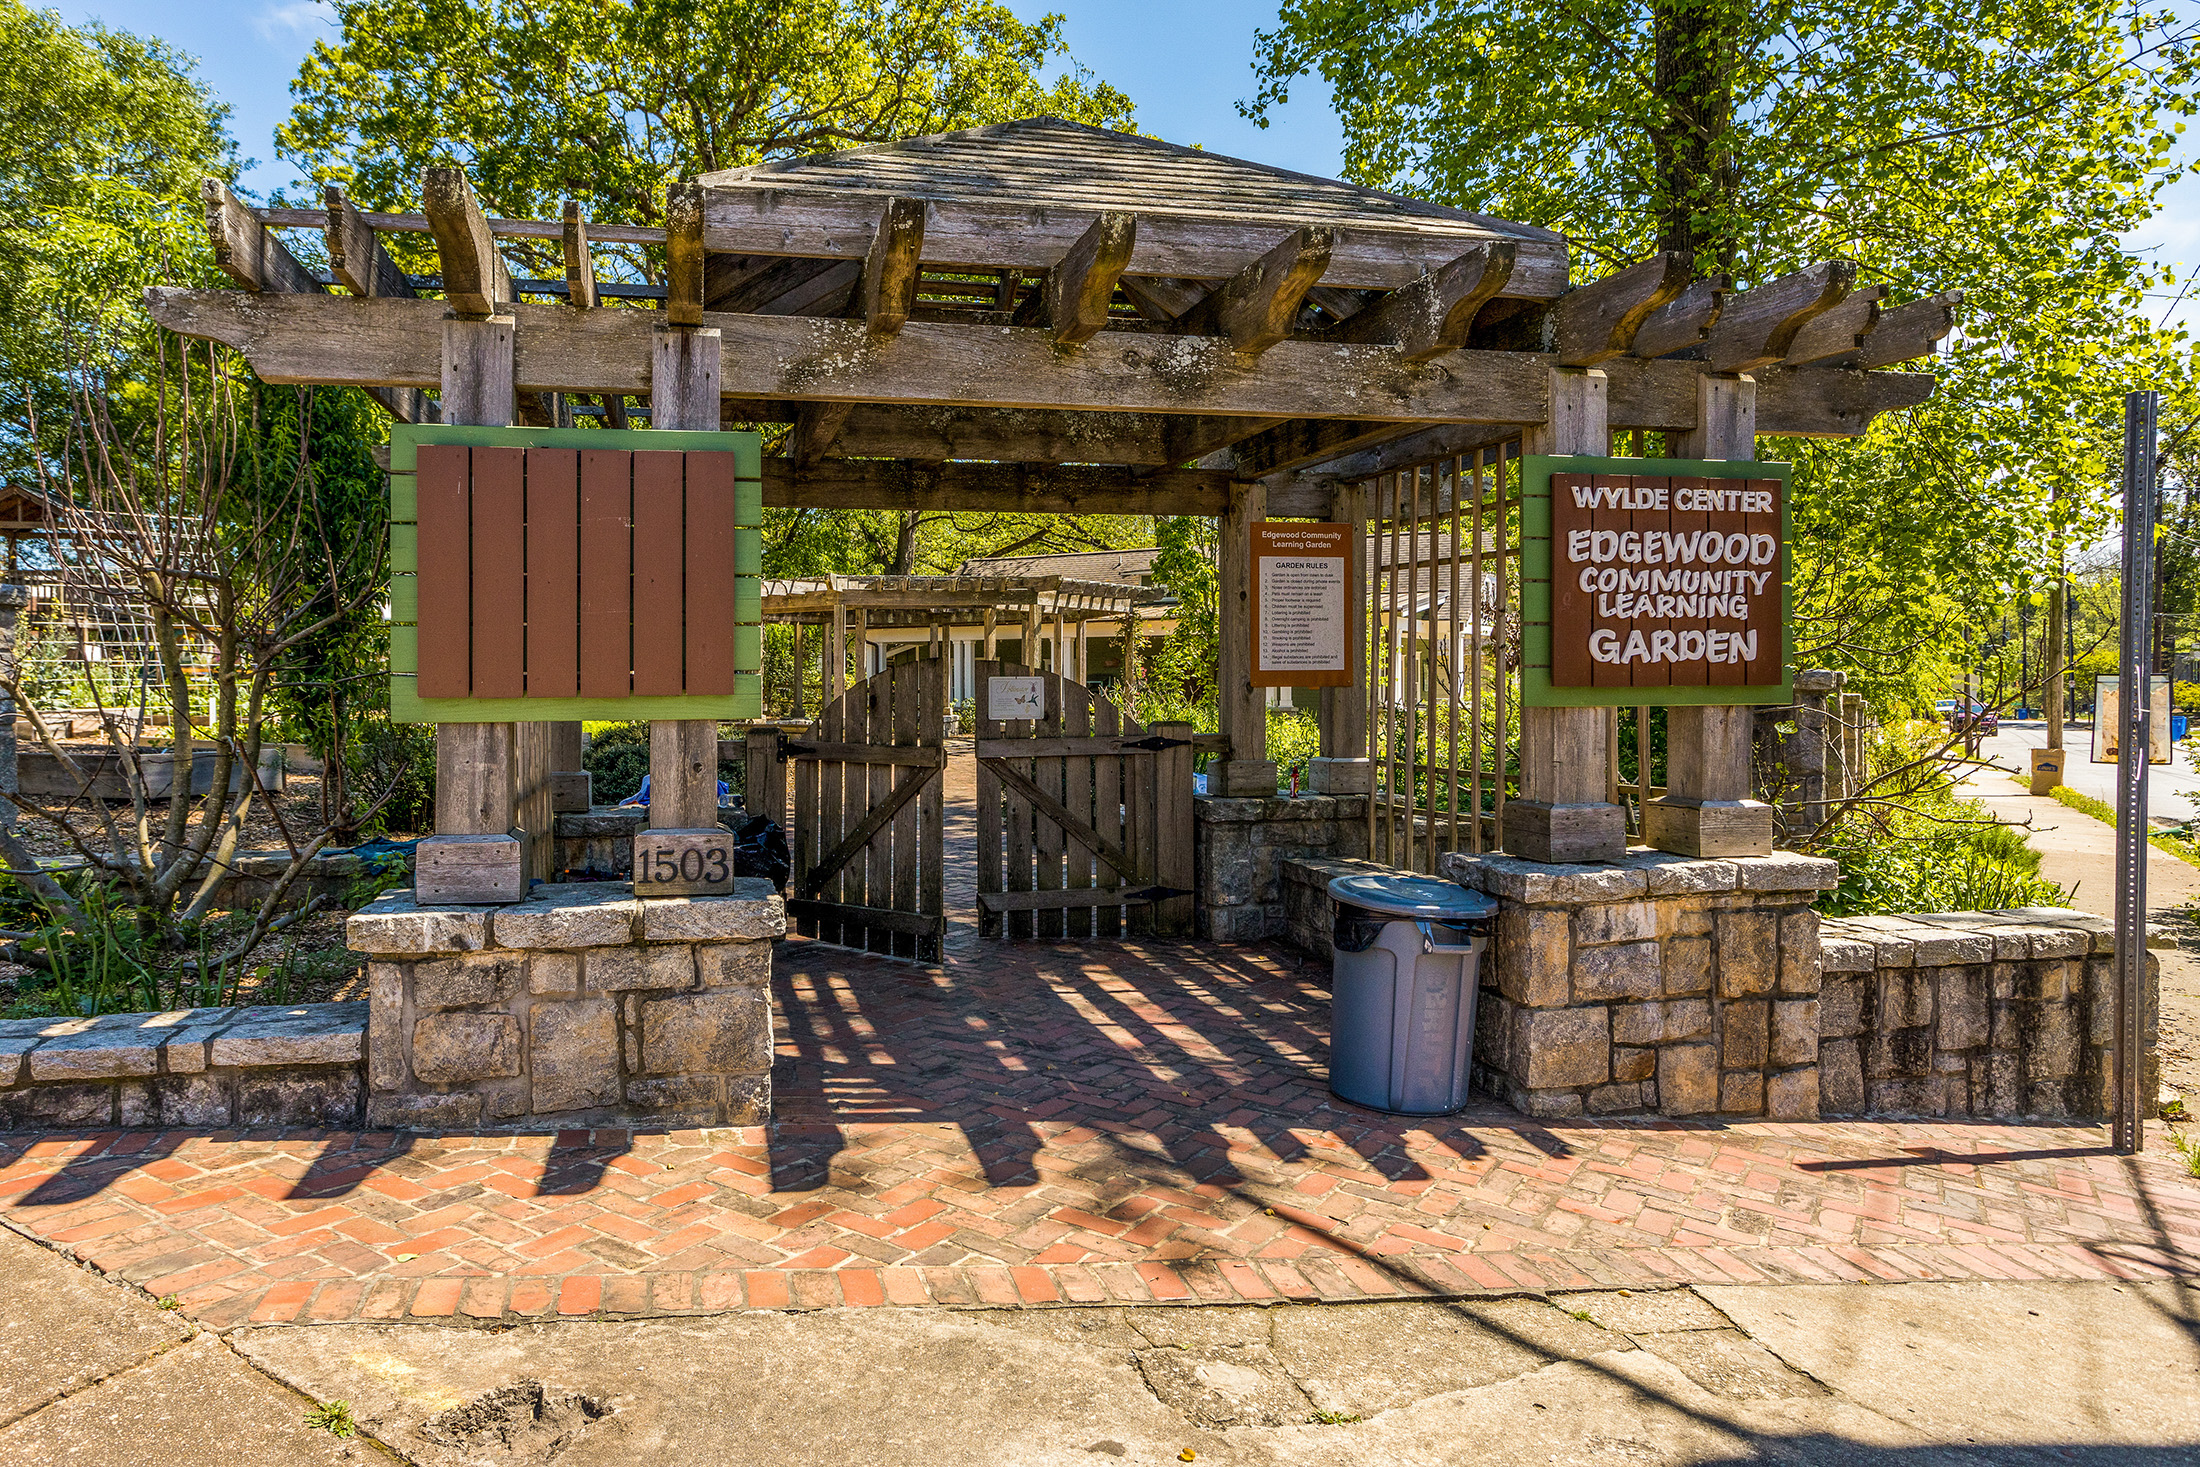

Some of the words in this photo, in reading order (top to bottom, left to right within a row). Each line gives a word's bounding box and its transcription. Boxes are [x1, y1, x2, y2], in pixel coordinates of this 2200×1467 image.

[1571, 486, 1669, 510] WYLDE
[1674, 488, 1774, 513] CENTER
[1262, 531, 1300, 539] Edgewood
[1301, 532, 1341, 540] Community
[1272, 541, 1304, 549] Learning
[1568, 529, 1776, 564] EDGEWOOD
[1579, 567, 1772, 595] COMMUNITY
[1598, 593, 1749, 620] LEARNING
[1589, 628, 1758, 664] GARDEN
[637, 848, 730, 884] 1503
